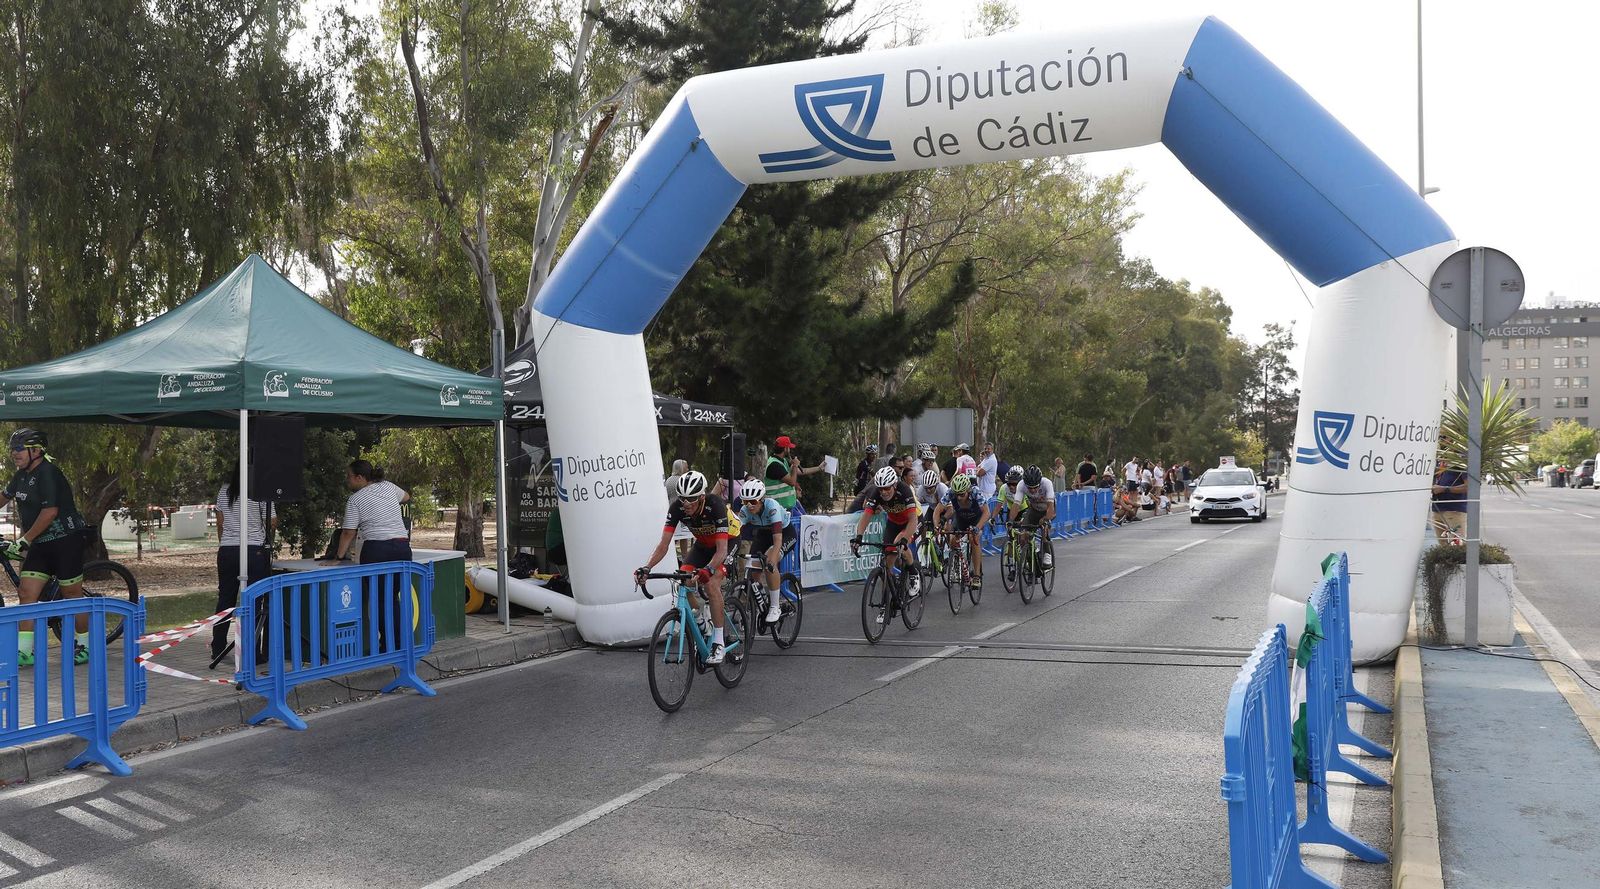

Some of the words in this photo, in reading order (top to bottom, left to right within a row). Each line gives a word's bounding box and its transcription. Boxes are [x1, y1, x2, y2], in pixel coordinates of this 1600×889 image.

[905, 47, 1128, 110] Diputación
[912, 126, 960, 159] de
[976, 111, 1093, 152] Cádiz
[1488, 326, 1551, 337] ALGECIRAS
[511, 405, 545, 419] 24
[694, 408, 727, 422] 24MX
[1363, 415, 1440, 444] Diputació
[567, 449, 646, 477] Diputación
[1360, 450, 1384, 473] de
[1393, 451, 1432, 476] Cádiz
[536, 486, 558, 496] SAR
[572, 484, 589, 502] de
[594, 478, 638, 500] Cádiz
[537, 498, 559, 508] BAR
[843, 558, 855, 573] DE
[856, 555, 881, 571] CICLISM
